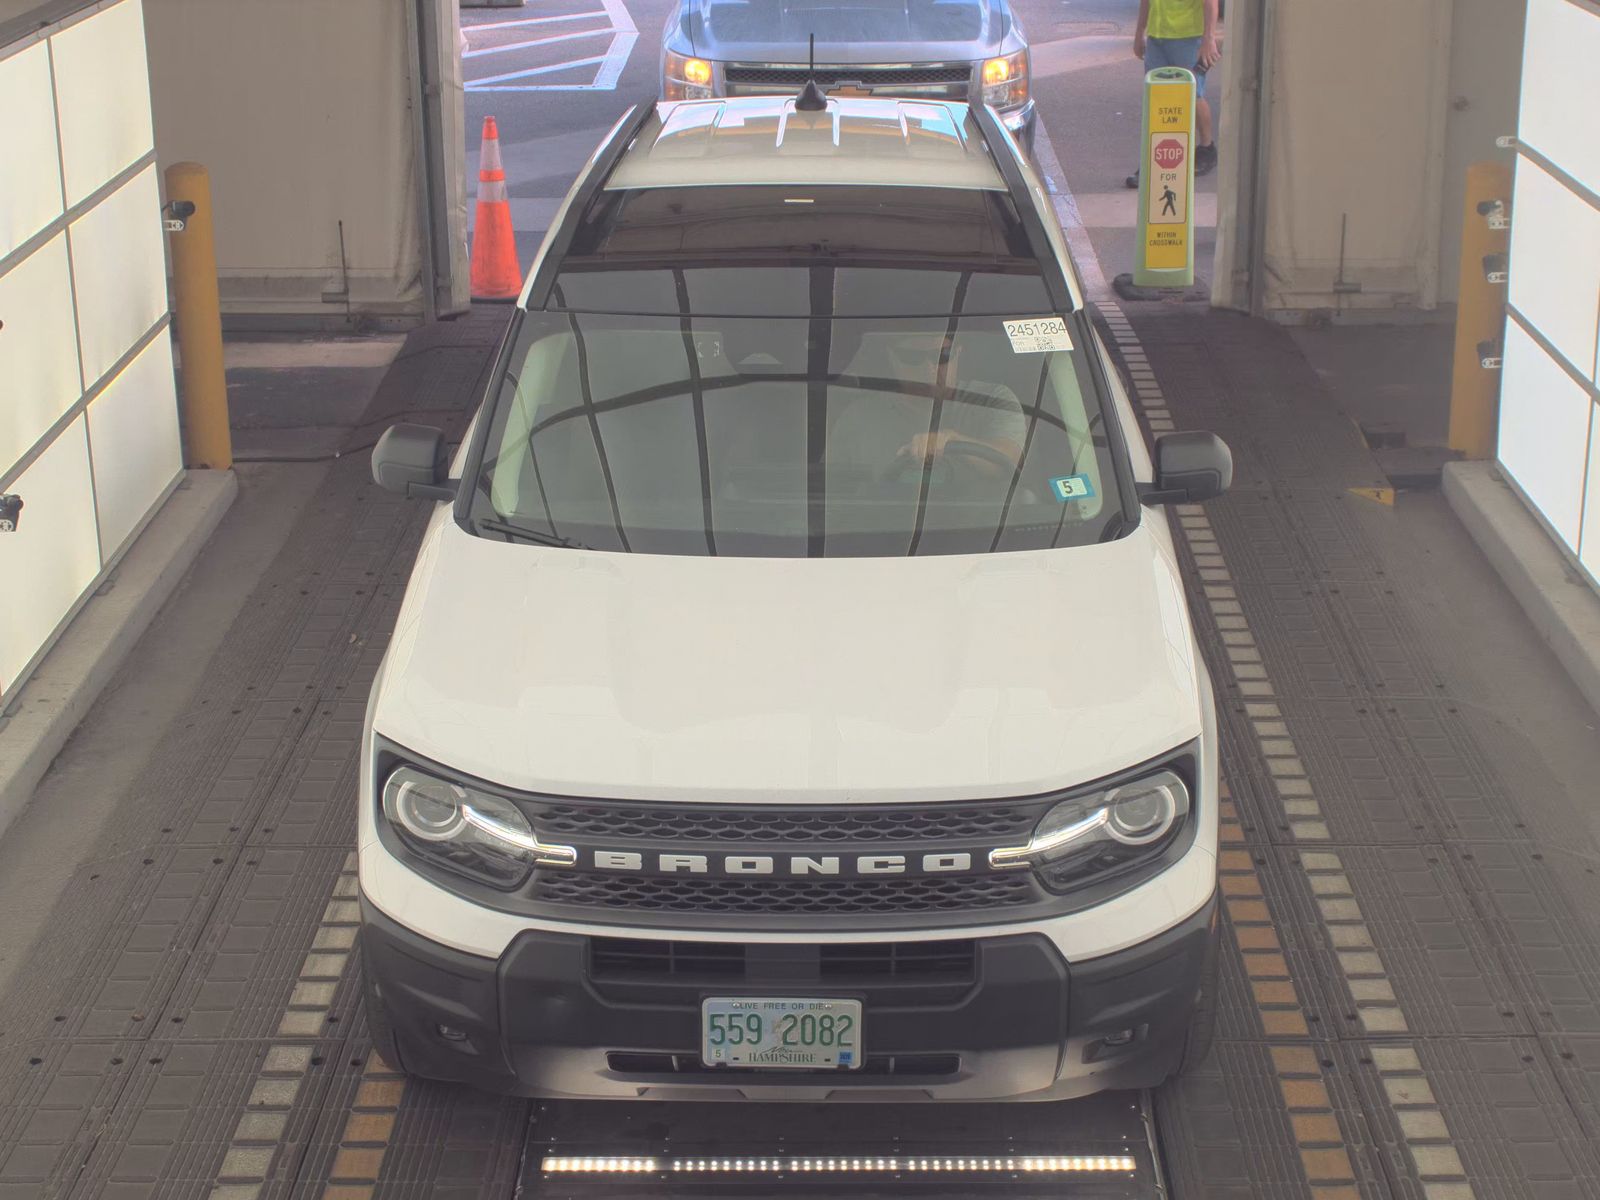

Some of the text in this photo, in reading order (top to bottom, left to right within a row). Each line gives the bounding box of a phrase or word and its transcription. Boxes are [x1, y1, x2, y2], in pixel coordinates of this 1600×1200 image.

[1158, 107, 1183, 115] STATE
[1162, 116, 1178, 124] LAW
[1155, 148, 1183, 160] STOP
[1160, 173, 1177, 181] FOR
[1007, 322, 1067, 337] 2451284
[1062, 480, 1074, 494] 5
[594, 850, 972, 875] BRONCO
[740, 1002, 759, 1010] LIVE
[763, 1002, 787, 1010] FREE
[709, 1013, 854, 1047] 559 2082
[748, 1052, 817, 1063] HAMPSHIRE
